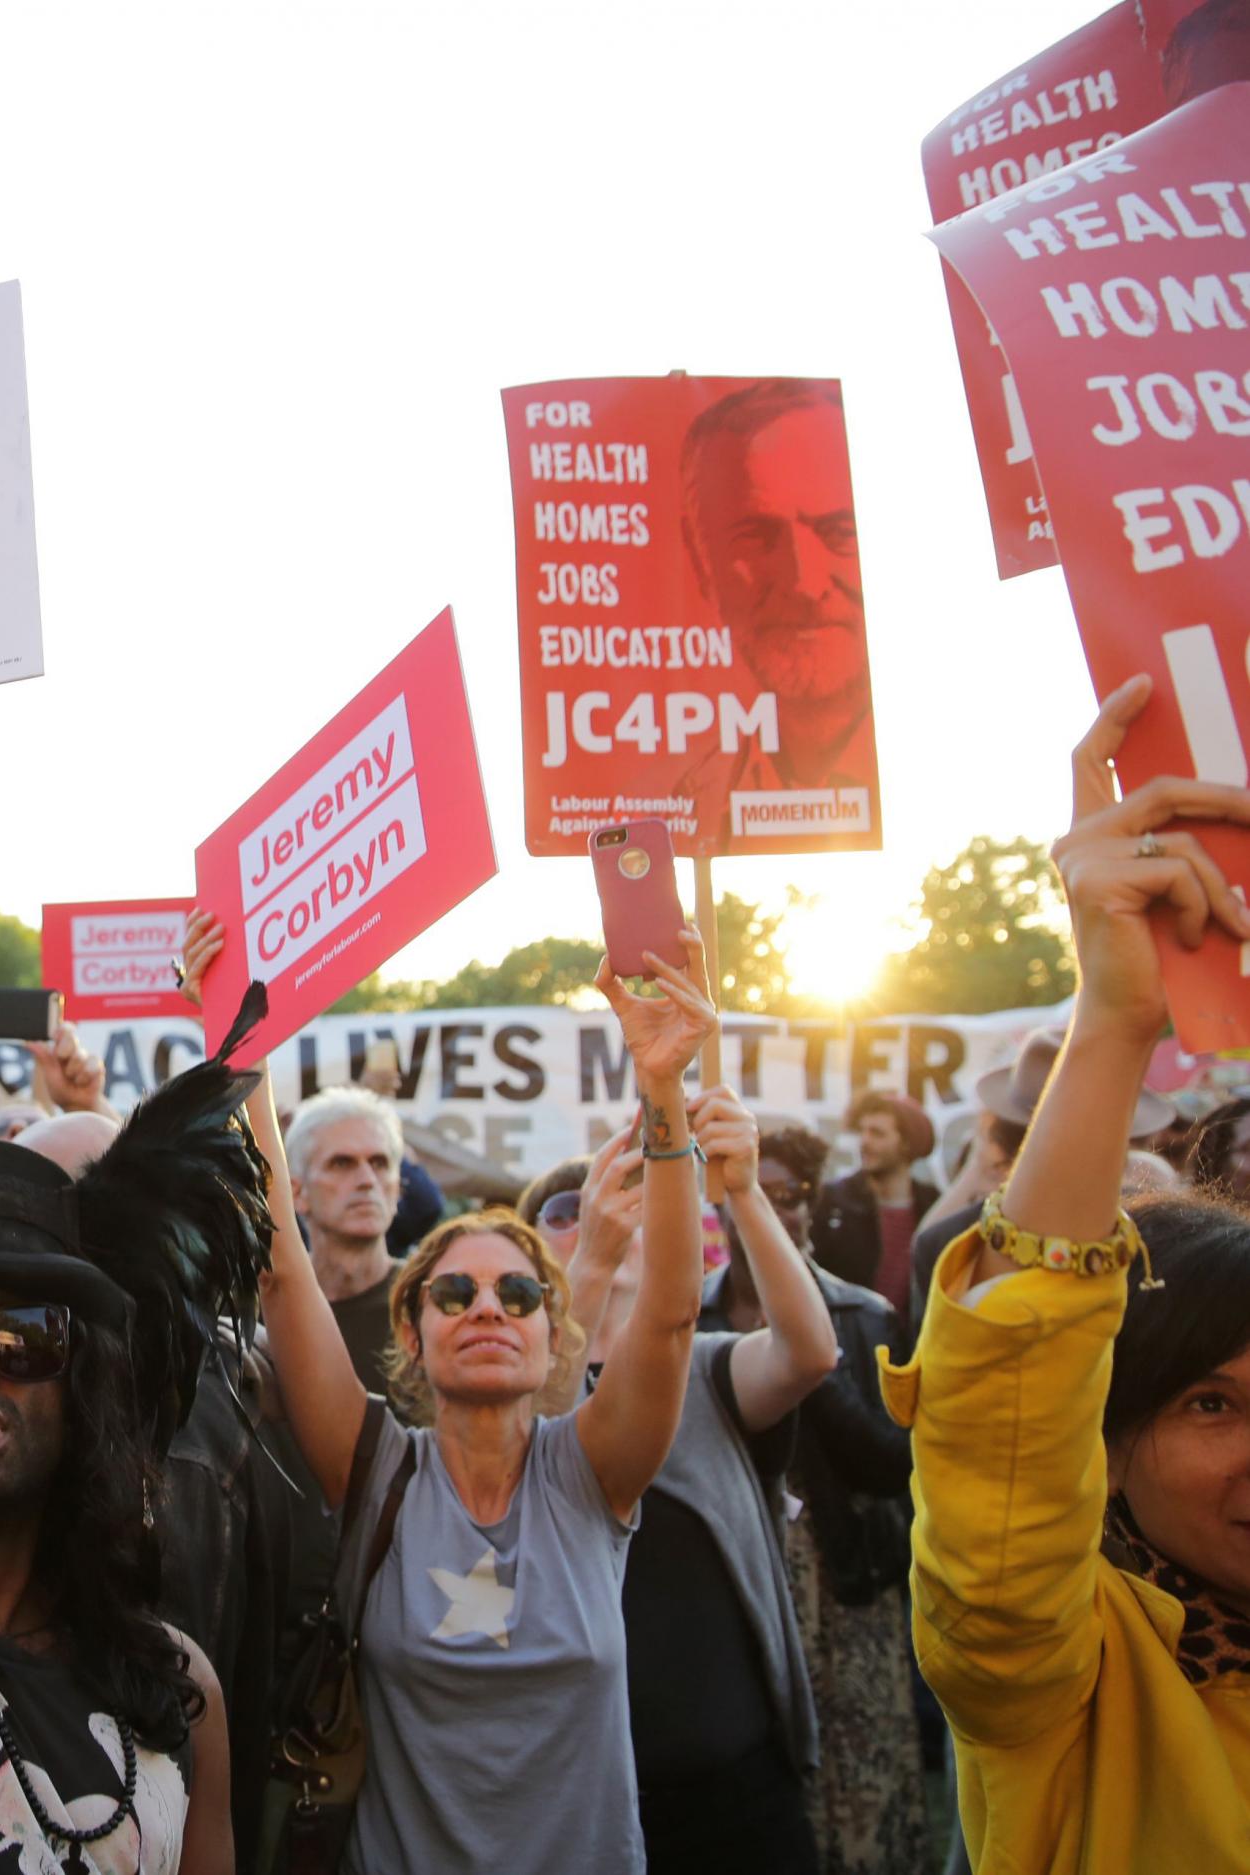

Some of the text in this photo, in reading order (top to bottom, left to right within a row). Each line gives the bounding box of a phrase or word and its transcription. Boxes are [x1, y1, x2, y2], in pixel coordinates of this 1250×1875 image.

[951, 69, 1118, 158] HEALTH
[983, 152, 1138, 224] FOR
[525, 401, 591, 428] FOR
[1086, 370, 1250, 446] JOB
[530, 442, 648, 484] HEALTH
[534, 502, 649, 546] HOMES
[1112, 479, 1250, 574] ED
[538, 563, 619, 607] JOBS
[539, 625, 733, 668] EDUCATION
[542, 691, 780, 768] JC4PM
[252, 730, 396, 888] Jeremy
[551, 794, 695, 818] Labour Assembly
[740, 796, 860, 830] MOMENTUM
[257, 817, 406, 962] Corbyn
[81, 923, 177, 947] Jeremy
[294, 911, 382, 991] jeremyforlabour.com
[578, 1024, 967, 1104] MTTER
